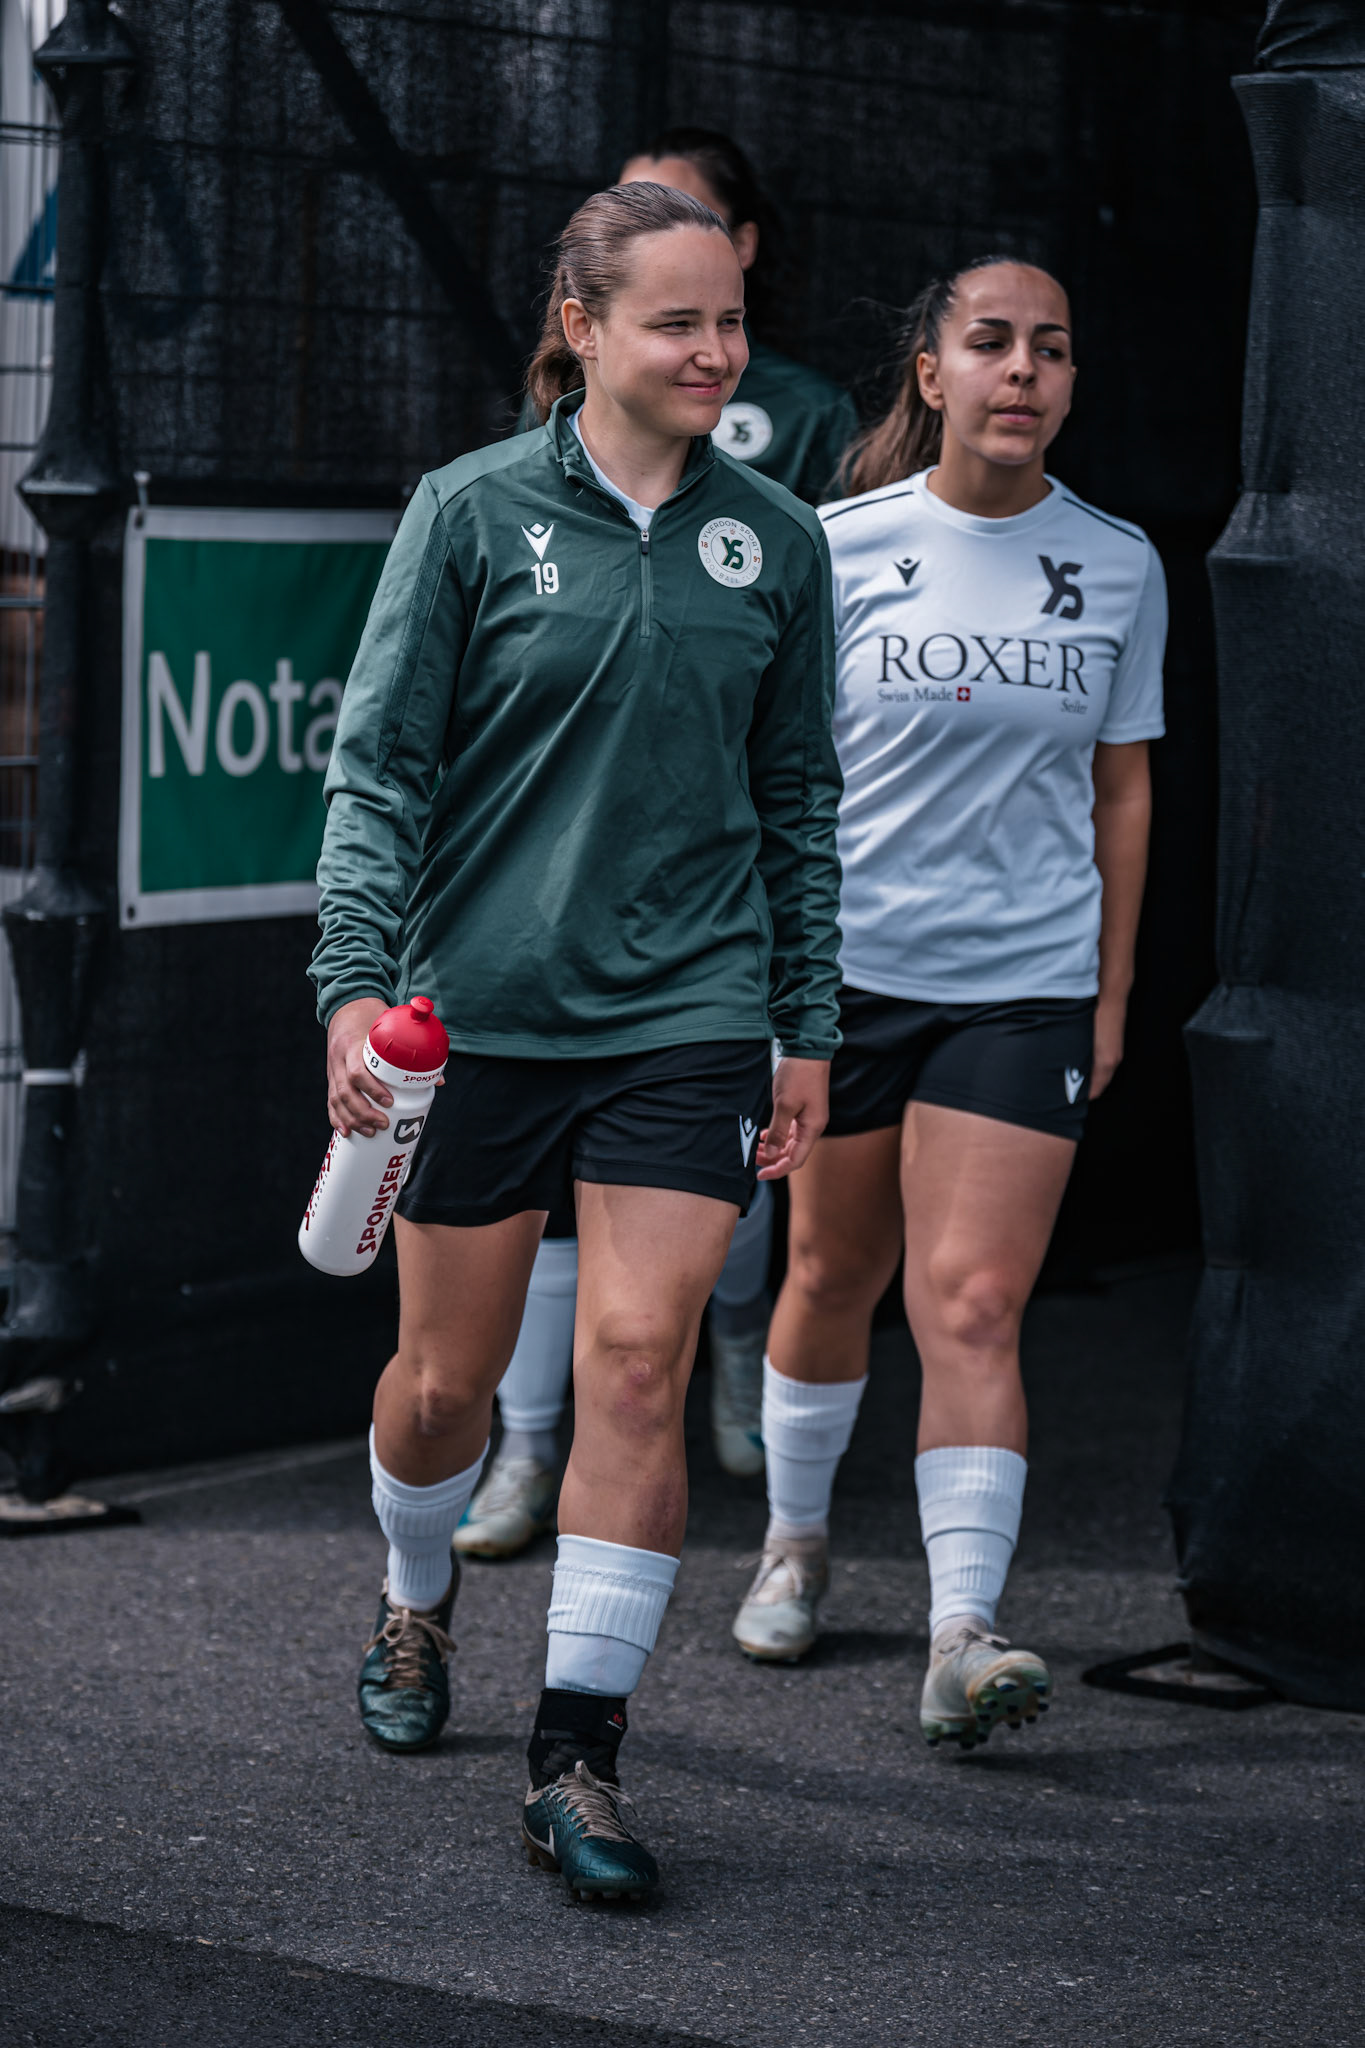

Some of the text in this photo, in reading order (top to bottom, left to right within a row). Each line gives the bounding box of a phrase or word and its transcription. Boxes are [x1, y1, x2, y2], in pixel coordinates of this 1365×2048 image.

[701, 540, 709, 553] 18
[703, 520, 759, 552] YVERDON SPORT
[530, 562, 560, 595] 19
[703, 552, 740, 584] FOOTBALL
[877, 633, 1089, 696] ROXER
[877, 686, 953, 704] Swiss Made
[402, 1071, 440, 1083] SPONSER
[356, 1152, 407, 1255] SPONSER
